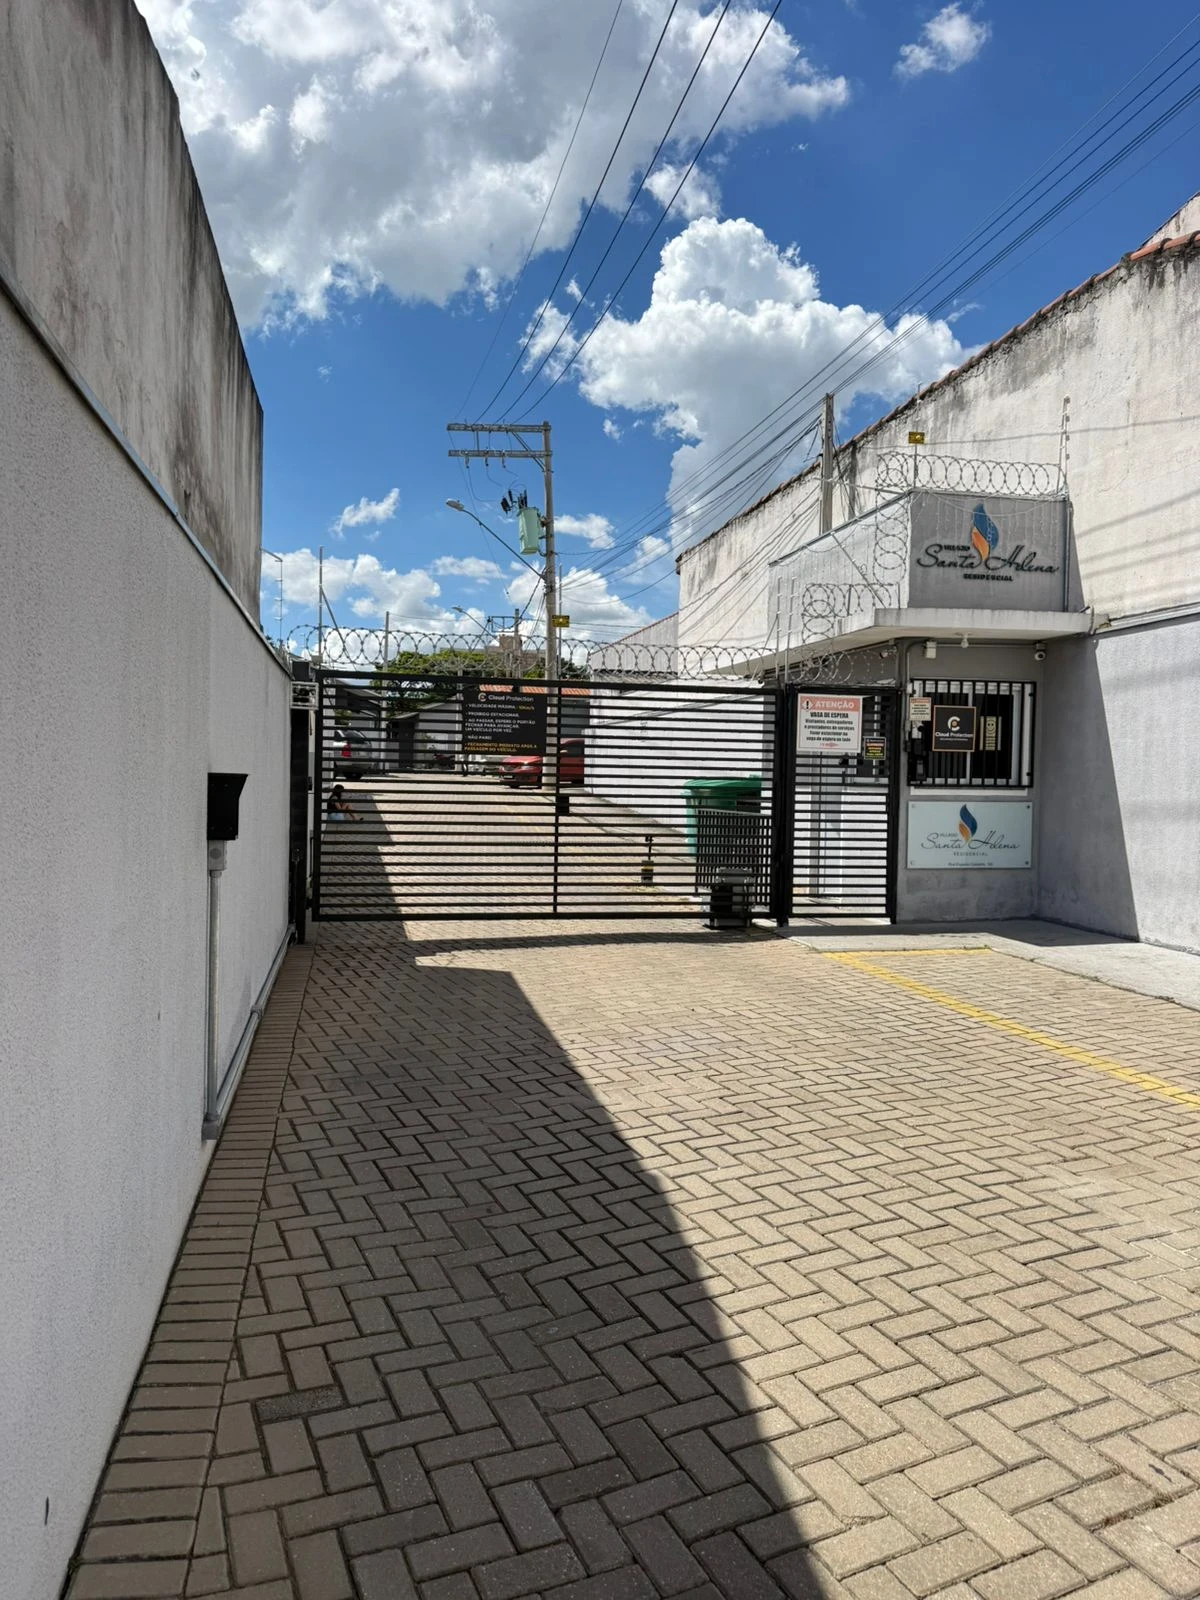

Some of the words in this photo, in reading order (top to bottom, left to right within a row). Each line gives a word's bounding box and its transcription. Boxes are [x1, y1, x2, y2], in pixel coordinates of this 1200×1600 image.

[916, 544, 980, 568] Santa
[984, 544, 1060, 574] Helena
[964, 573, 1014, 582] RESIDENCIAL
[814, 700, 854, 709] ATENÇÃO
[921, 832, 966, 849] Santa
[968, 830, 1020, 849] Helena
